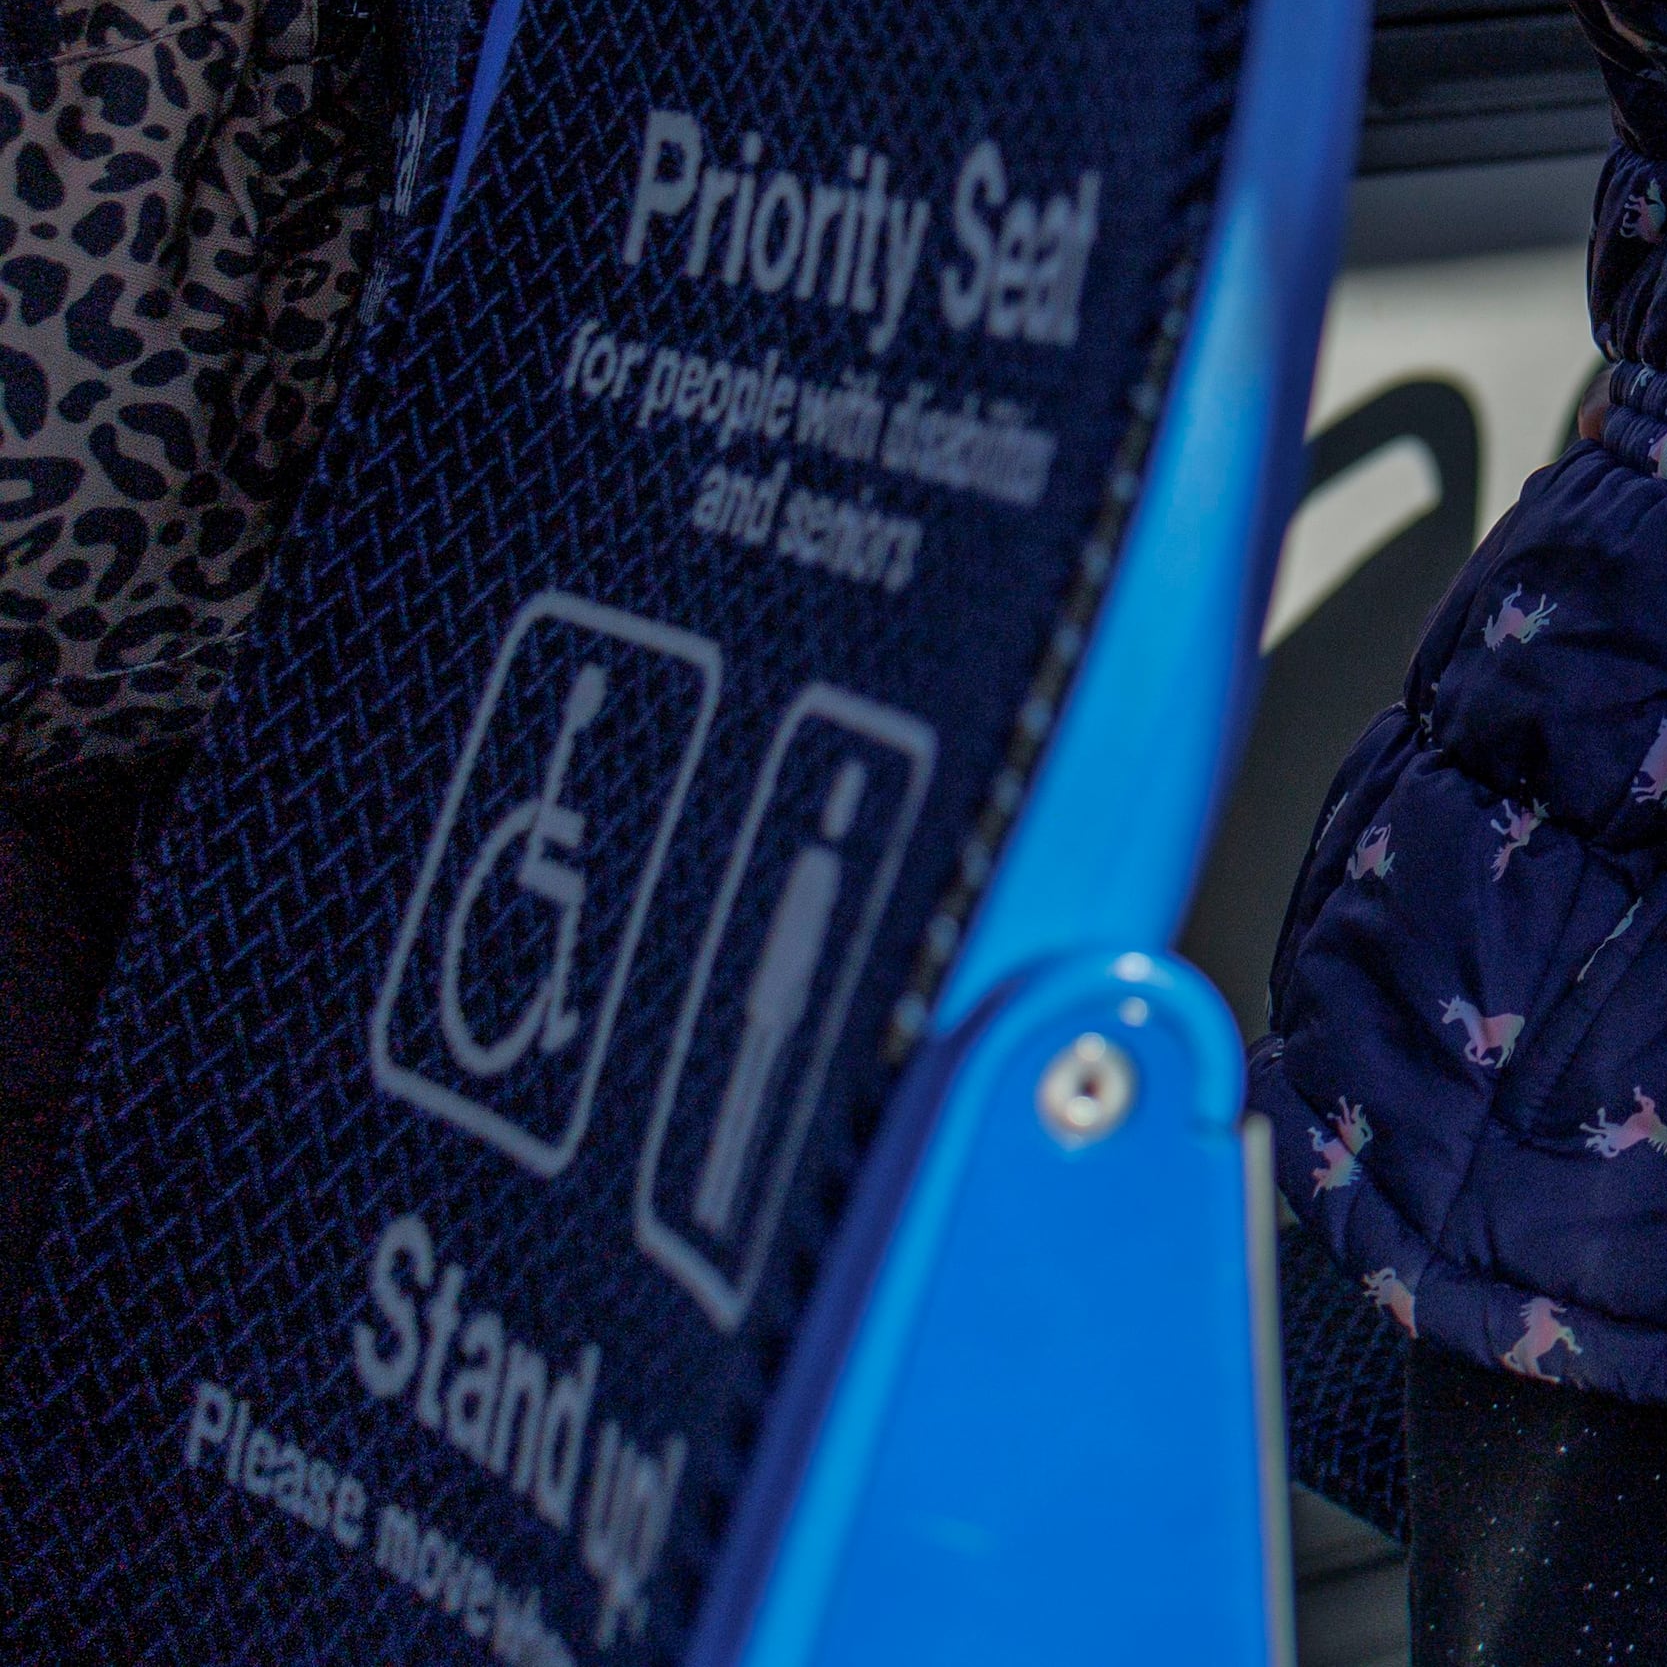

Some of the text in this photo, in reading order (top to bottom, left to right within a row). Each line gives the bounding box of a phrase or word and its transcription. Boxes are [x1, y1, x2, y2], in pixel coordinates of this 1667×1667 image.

[623, 110, 1100, 355] Priority Seat
[563, 319, 646, 400] for
[636, 348, 799, 448] people
[796, 368, 885, 460] with
[692, 458, 923, 593] and seniors
[353, 1213, 602, 1530] Stand
[185, 1381, 369, 1549] Please
[374, 1502, 497, 1636] move
